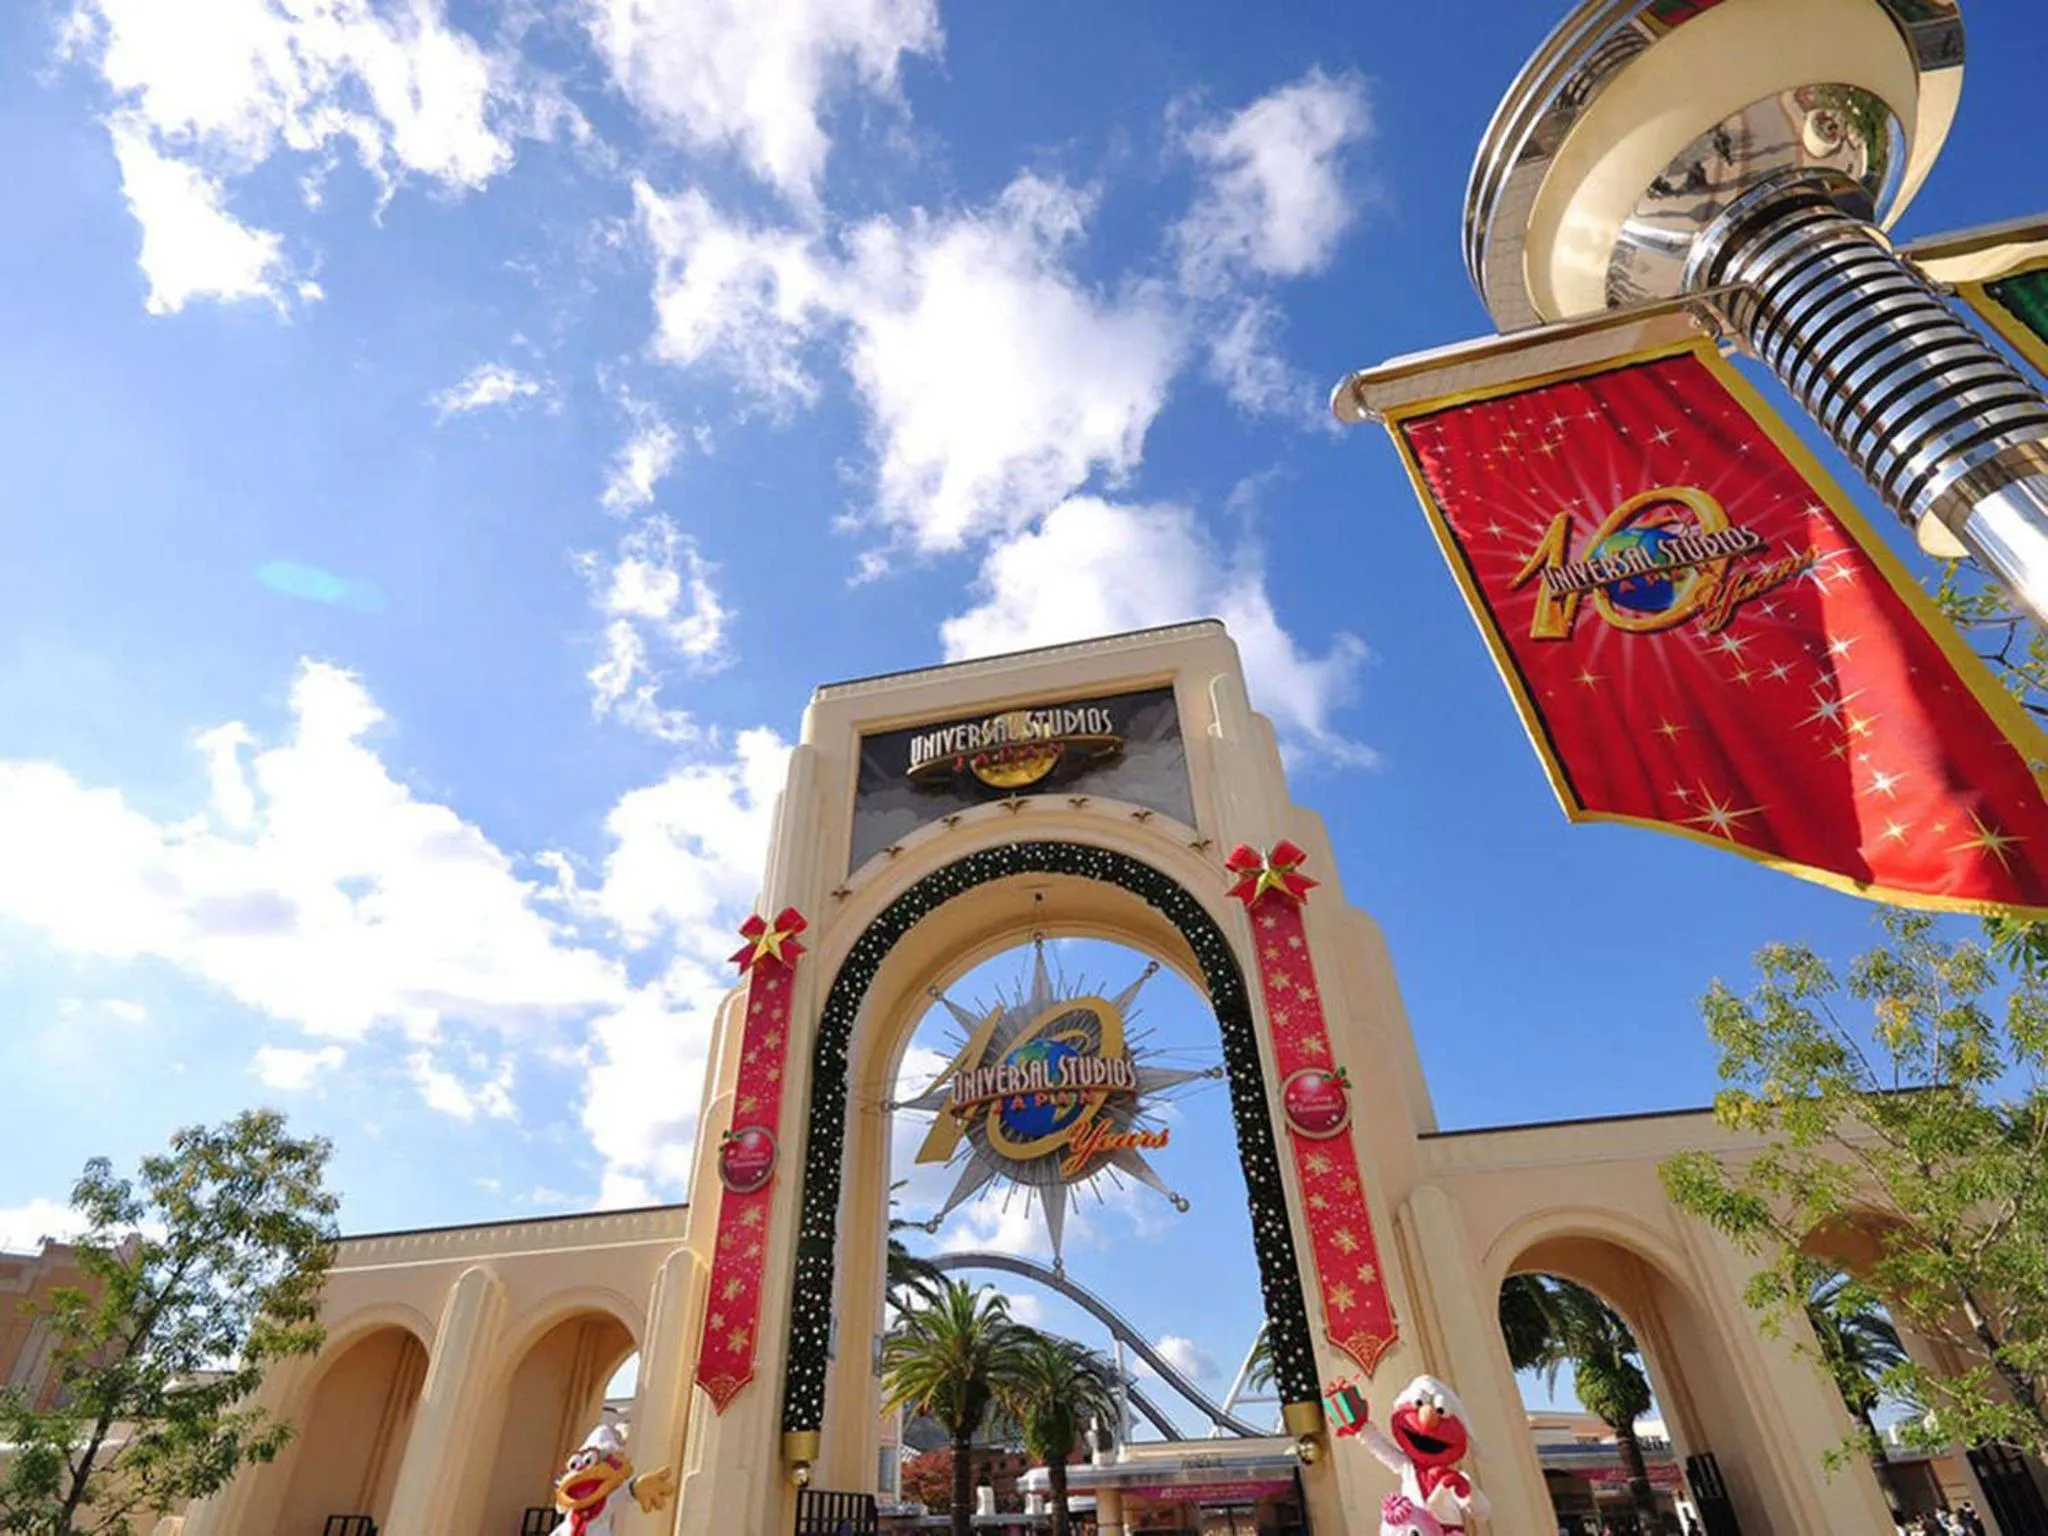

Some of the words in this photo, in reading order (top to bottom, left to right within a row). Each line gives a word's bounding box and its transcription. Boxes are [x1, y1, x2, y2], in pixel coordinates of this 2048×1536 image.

[1539, 543, 1659, 593] UNIVERSAL
[1656, 524, 1762, 566] STUDIOS
[909, 715, 1020, 767] UNIVERSAL
[1023, 707, 1113, 740] STUDIOS
[951, 1060, 1052, 1104] UNIVERSAL
[1058, 1055, 1137, 1089] STUDIOS
[1059, 1116, 1171, 1178] Years
